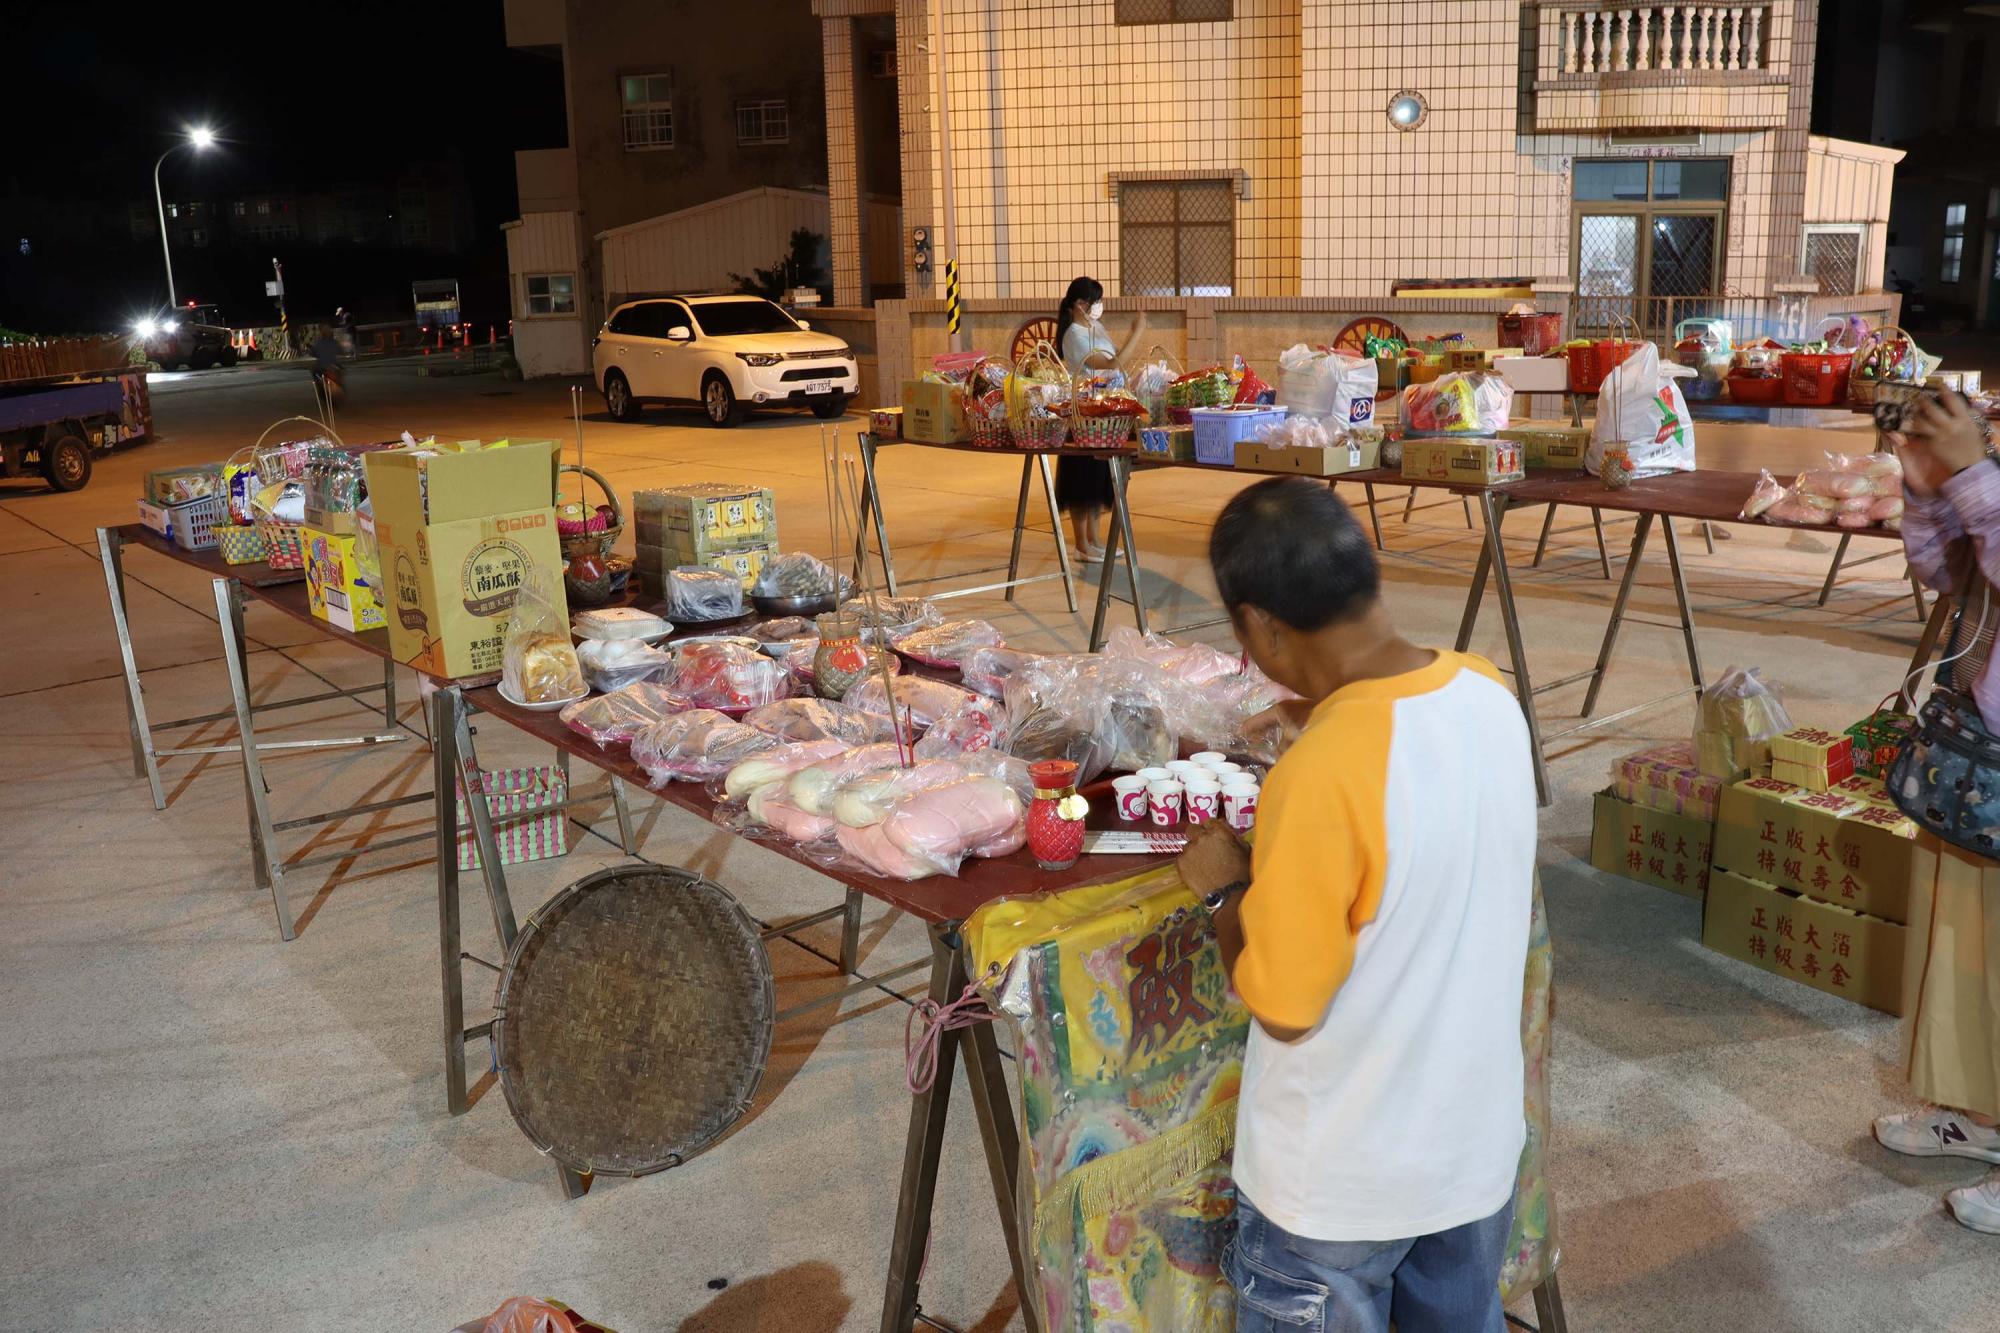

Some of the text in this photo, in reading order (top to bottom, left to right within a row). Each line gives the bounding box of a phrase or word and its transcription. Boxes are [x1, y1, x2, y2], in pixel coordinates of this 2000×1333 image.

[476, 570, 521, 593] 南瓜酥
[1760, 820, 1862, 870] 正版大箔
[1757, 848, 1862, 899] 特級壽金
[1750, 907, 1851, 958] 正版大箔
[1749, 935, 1851, 988] 特級壽金
